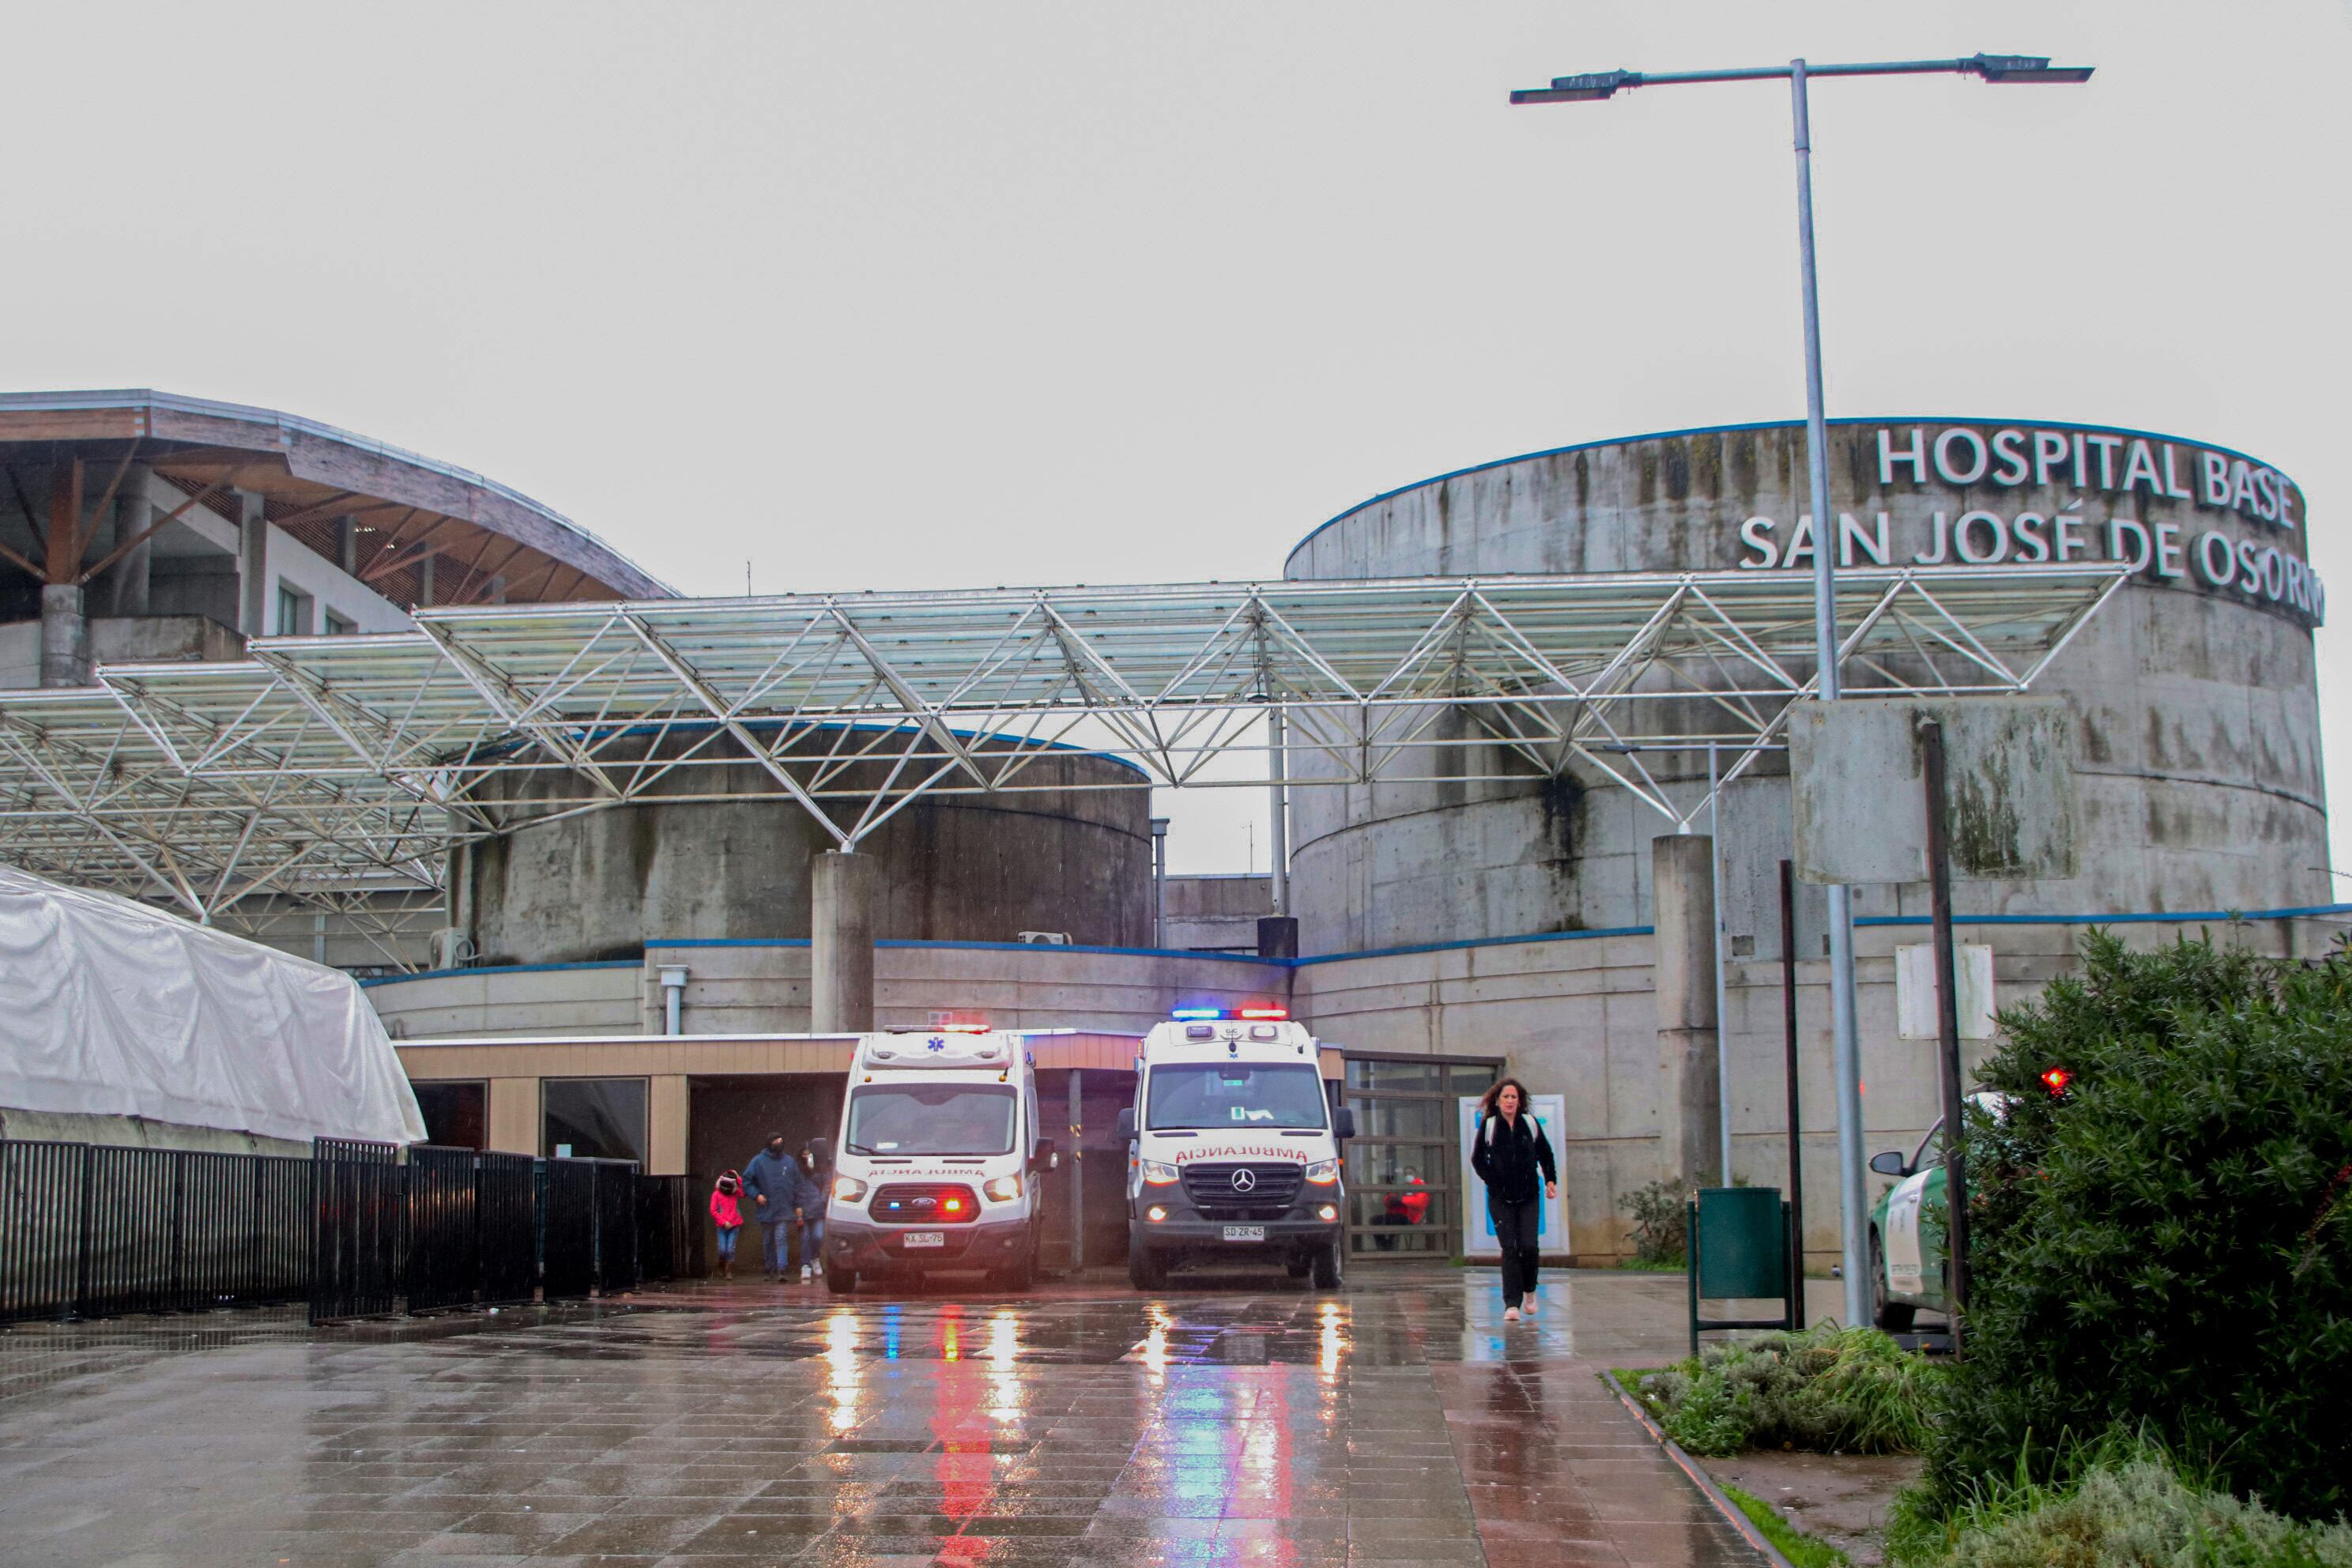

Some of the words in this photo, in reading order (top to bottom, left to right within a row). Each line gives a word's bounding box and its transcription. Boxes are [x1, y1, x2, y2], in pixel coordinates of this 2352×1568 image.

[1877, 428, 2190, 499] HOSPITAL
[2202, 451, 2294, 530] BASE
[1740, 512, 1890, 568] SAN
[1913, 497, 2086, 564] JOSÉ
[2109, 518, 2184, 578] DE
